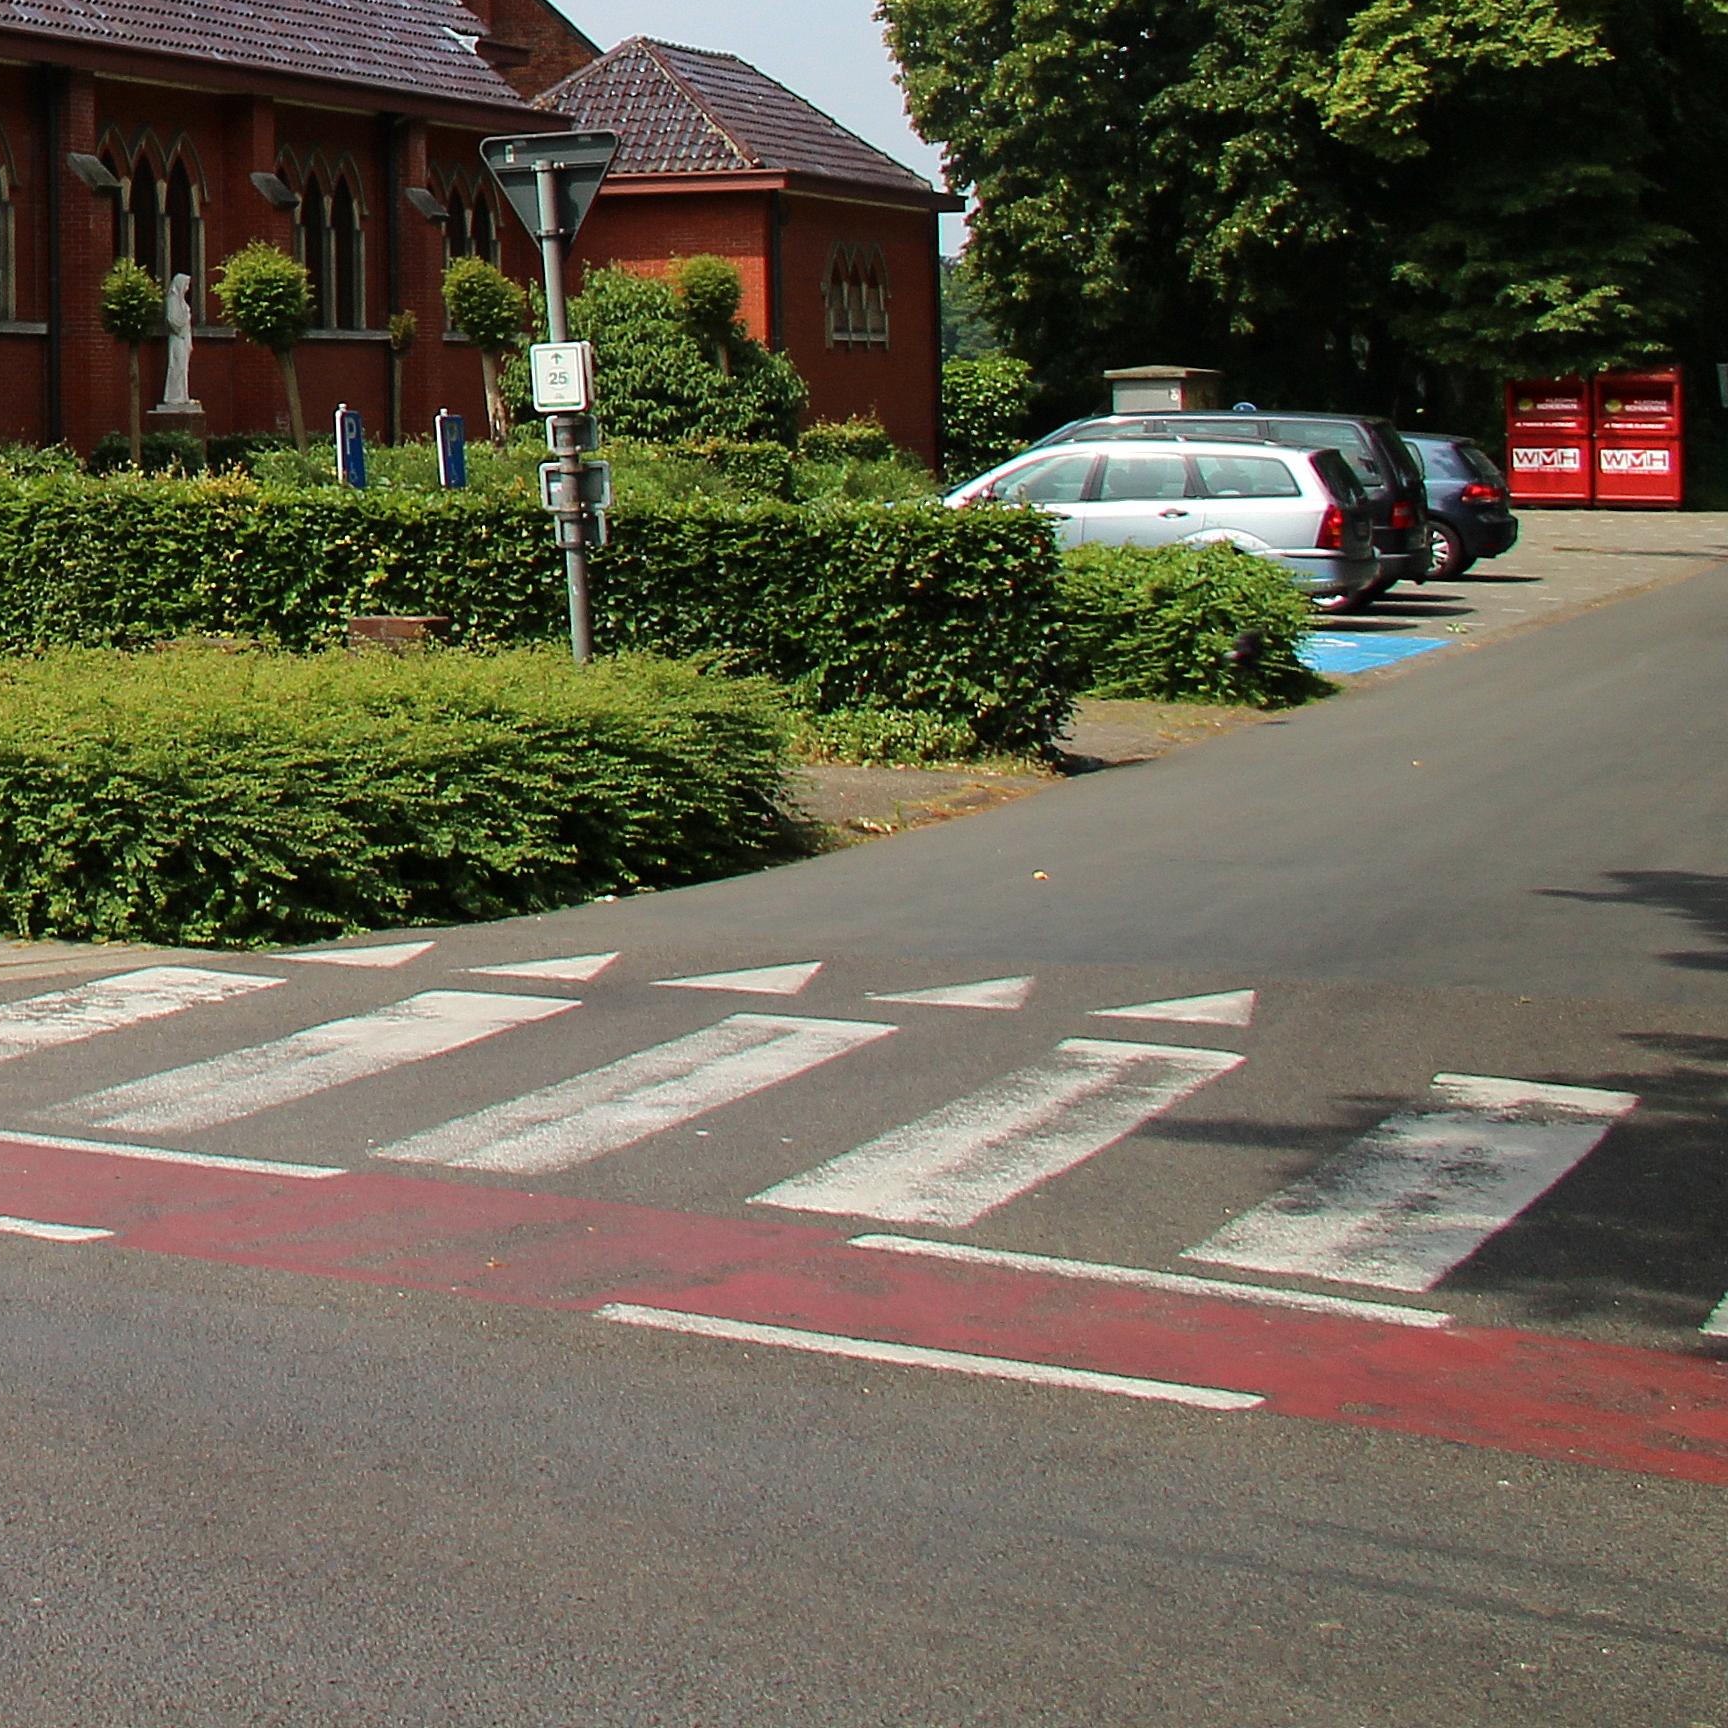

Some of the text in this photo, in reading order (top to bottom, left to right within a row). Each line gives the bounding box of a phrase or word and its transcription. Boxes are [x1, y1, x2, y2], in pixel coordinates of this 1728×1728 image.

[548, 372, 568, 385] 25
[345, 416, 357, 455] P
[1515, 449, 1577, 465] WMH
[1603, 451, 1667, 468] WMH
